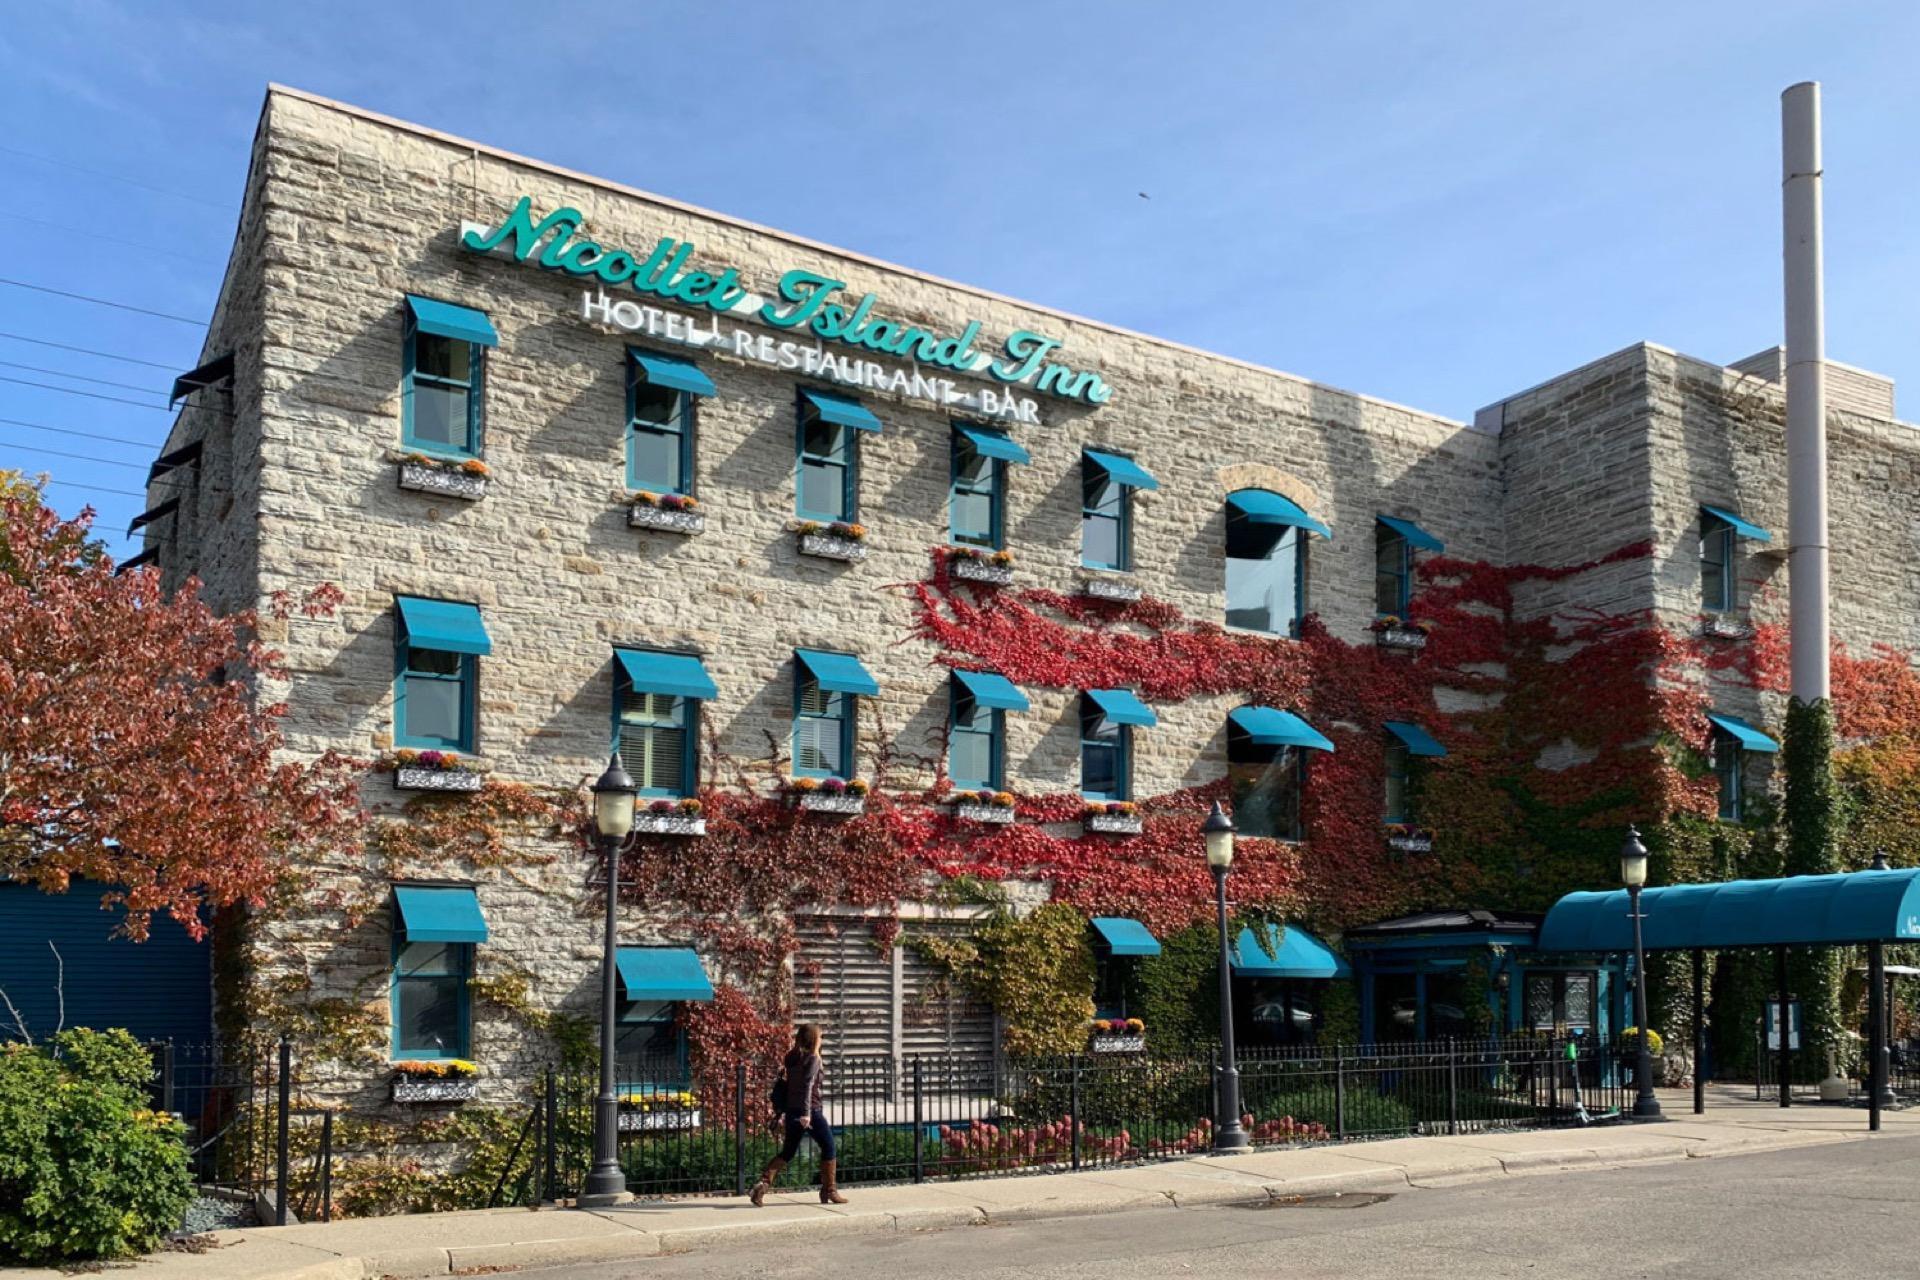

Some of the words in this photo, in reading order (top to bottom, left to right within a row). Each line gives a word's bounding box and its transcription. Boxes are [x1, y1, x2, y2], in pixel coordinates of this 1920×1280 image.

[463, 195, 747, 311] Nicollet
[759, 269, 982, 371] Island
[988, 331, 1112, 404] Inn
[583, 291, 704, 345] HOTEL
[733, 329, 956, 404] RESTAURANT
[981, 388, 1040, 424] BAR
